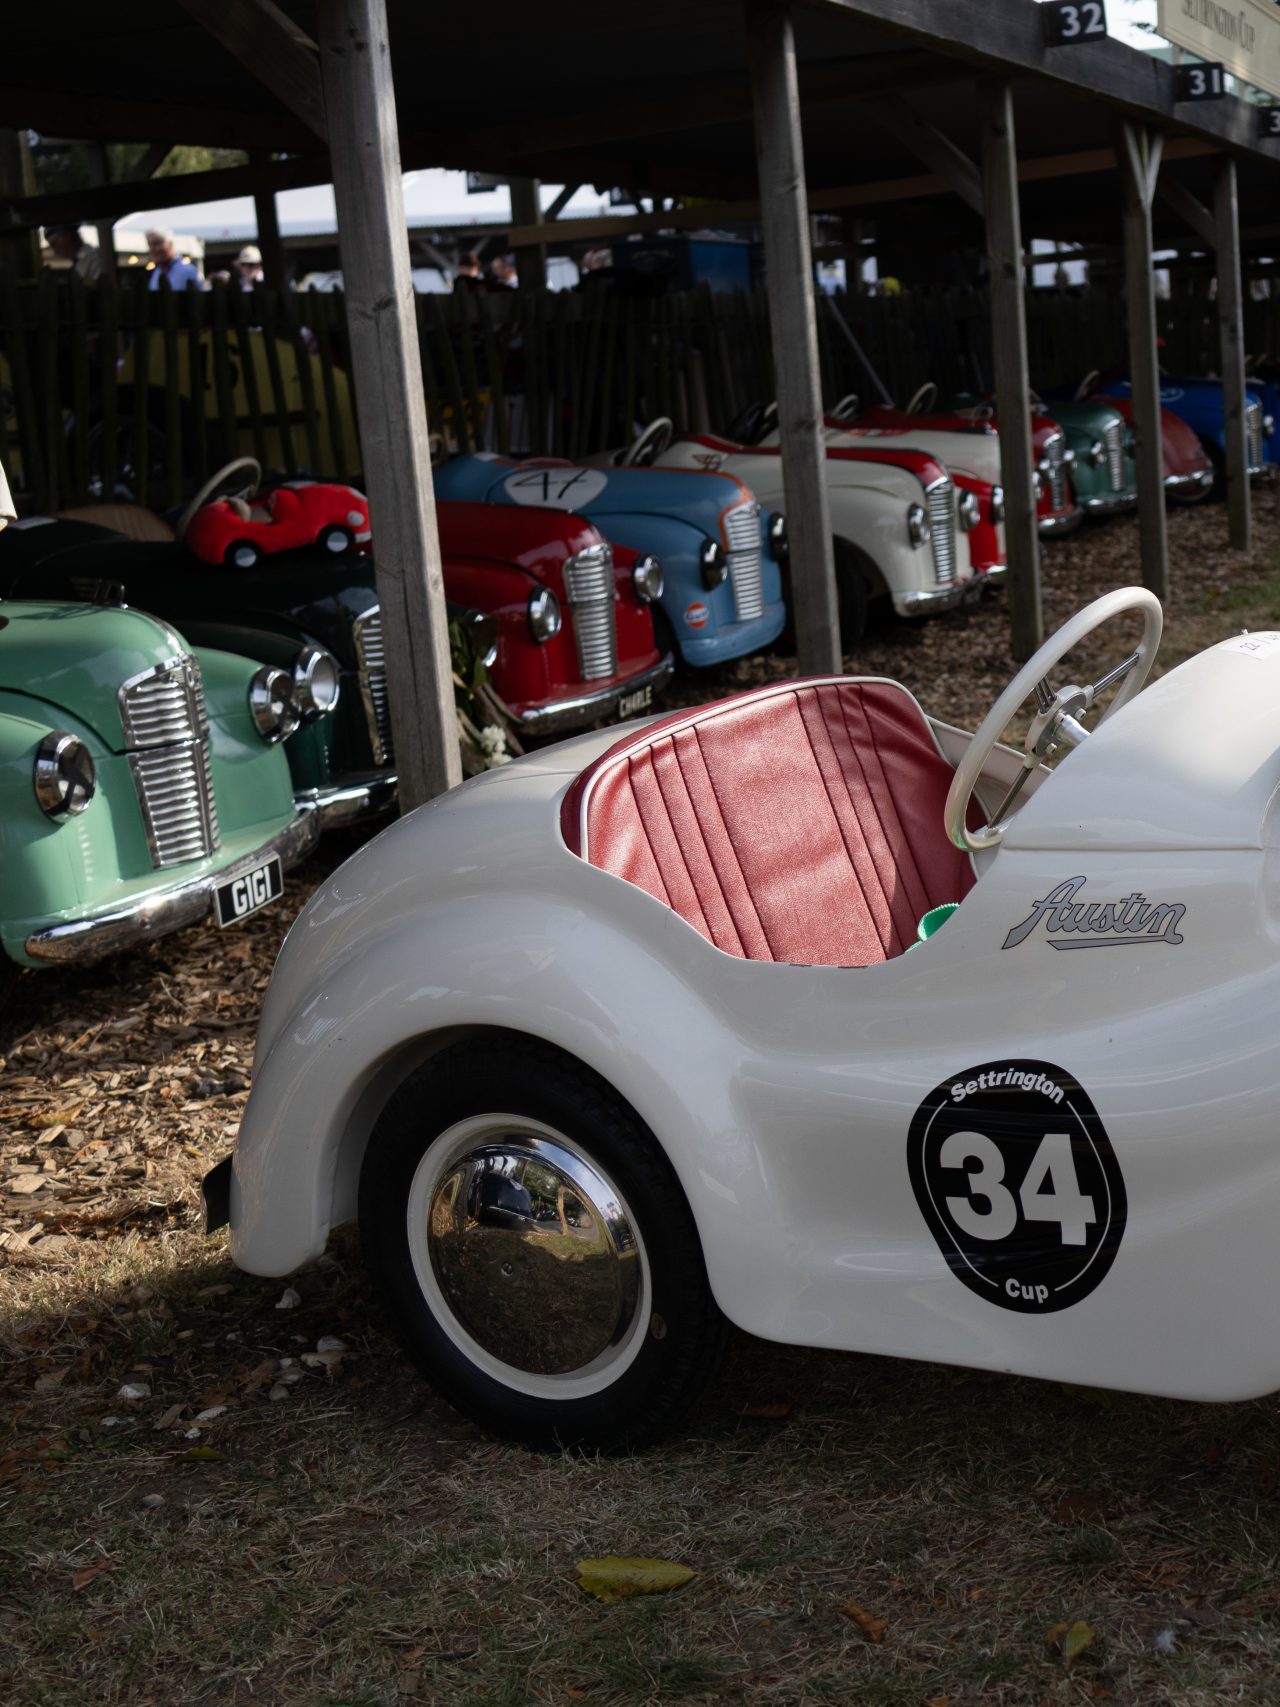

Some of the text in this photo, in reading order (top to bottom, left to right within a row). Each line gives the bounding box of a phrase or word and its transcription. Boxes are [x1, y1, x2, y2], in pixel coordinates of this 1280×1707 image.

[1060, 3, 1104, 37] 32
[1189, 69, 1221, 95] 31
[513, 468, 588, 501] 47
[1001, 876, 1187, 950] Austin
[951, 1068, 1065, 1104] Settrington
[940, 1131, 1097, 1246] 34
[1005, 1278, 1049, 1304] Cup
